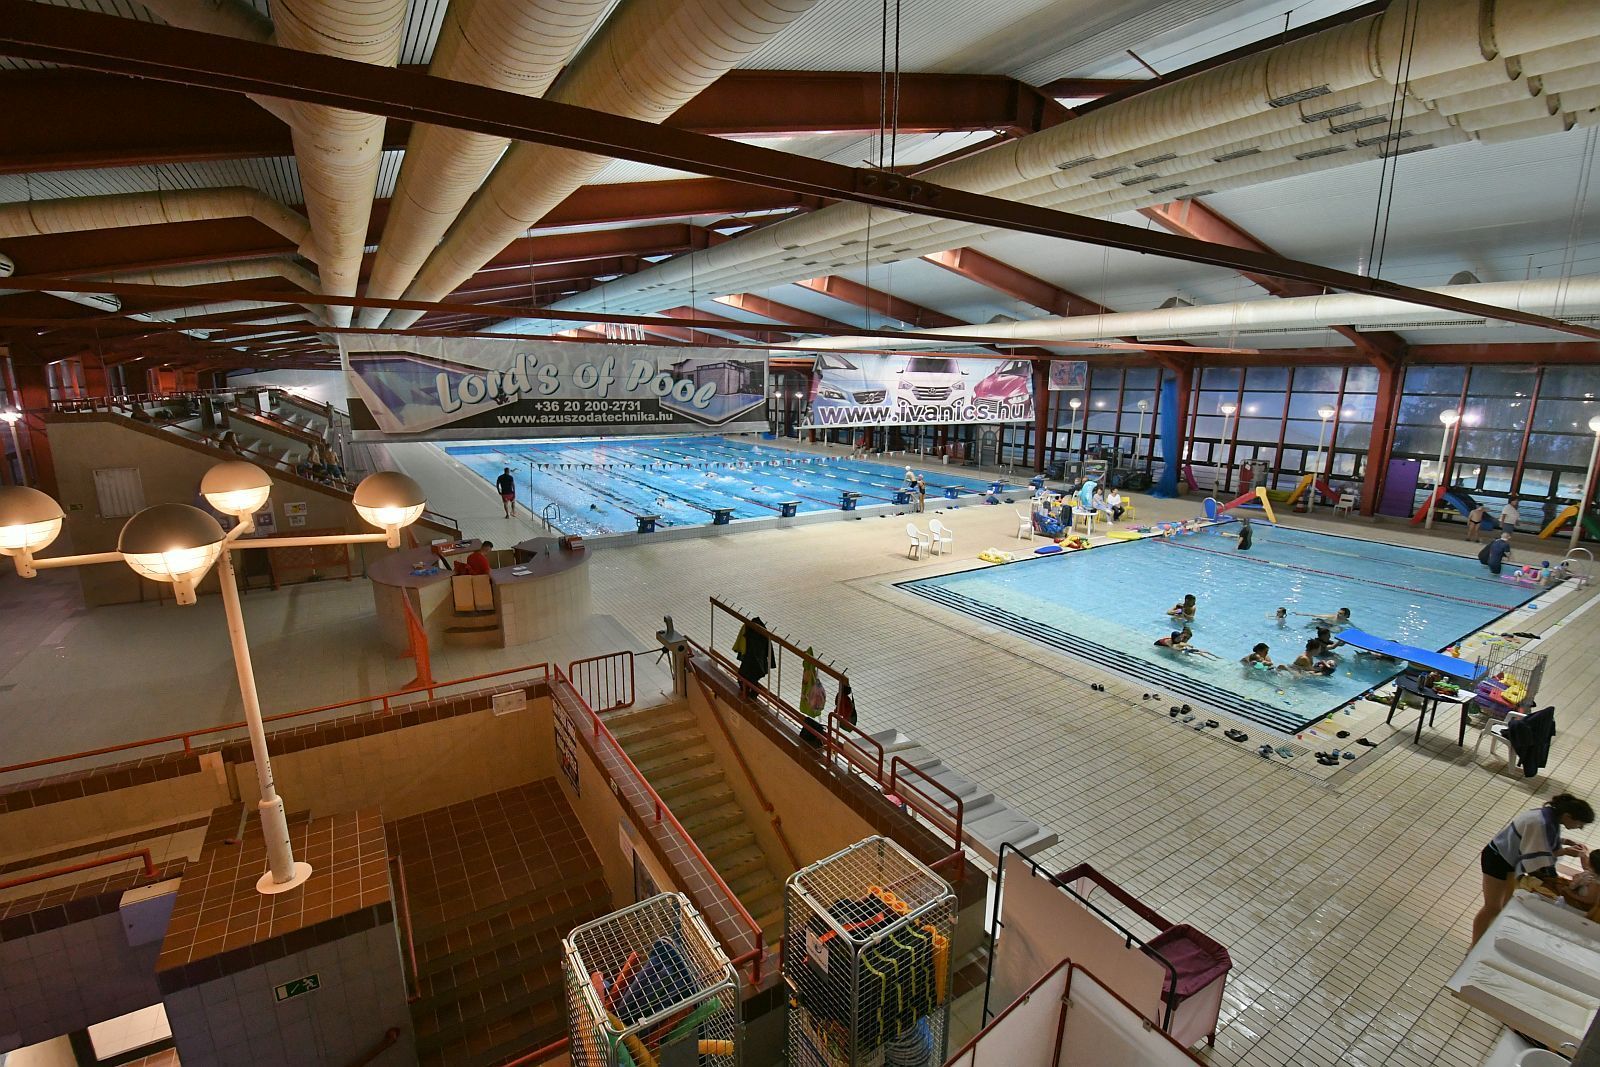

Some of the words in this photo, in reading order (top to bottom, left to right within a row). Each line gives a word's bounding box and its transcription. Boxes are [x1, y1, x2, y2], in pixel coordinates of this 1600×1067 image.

[436, 353, 560, 413] Lord's
[573, 355, 615, 398] of
[626, 359, 717, 409] Pool
[534, 400, 560, 412] +36
[563, 401, 580, 411] 20
[584, 400, 641, 411] 200-2731
[817, 400, 1025, 425] www.ivanics.hu
[496, 411, 673, 424] www.azuszodatechnika.hu
